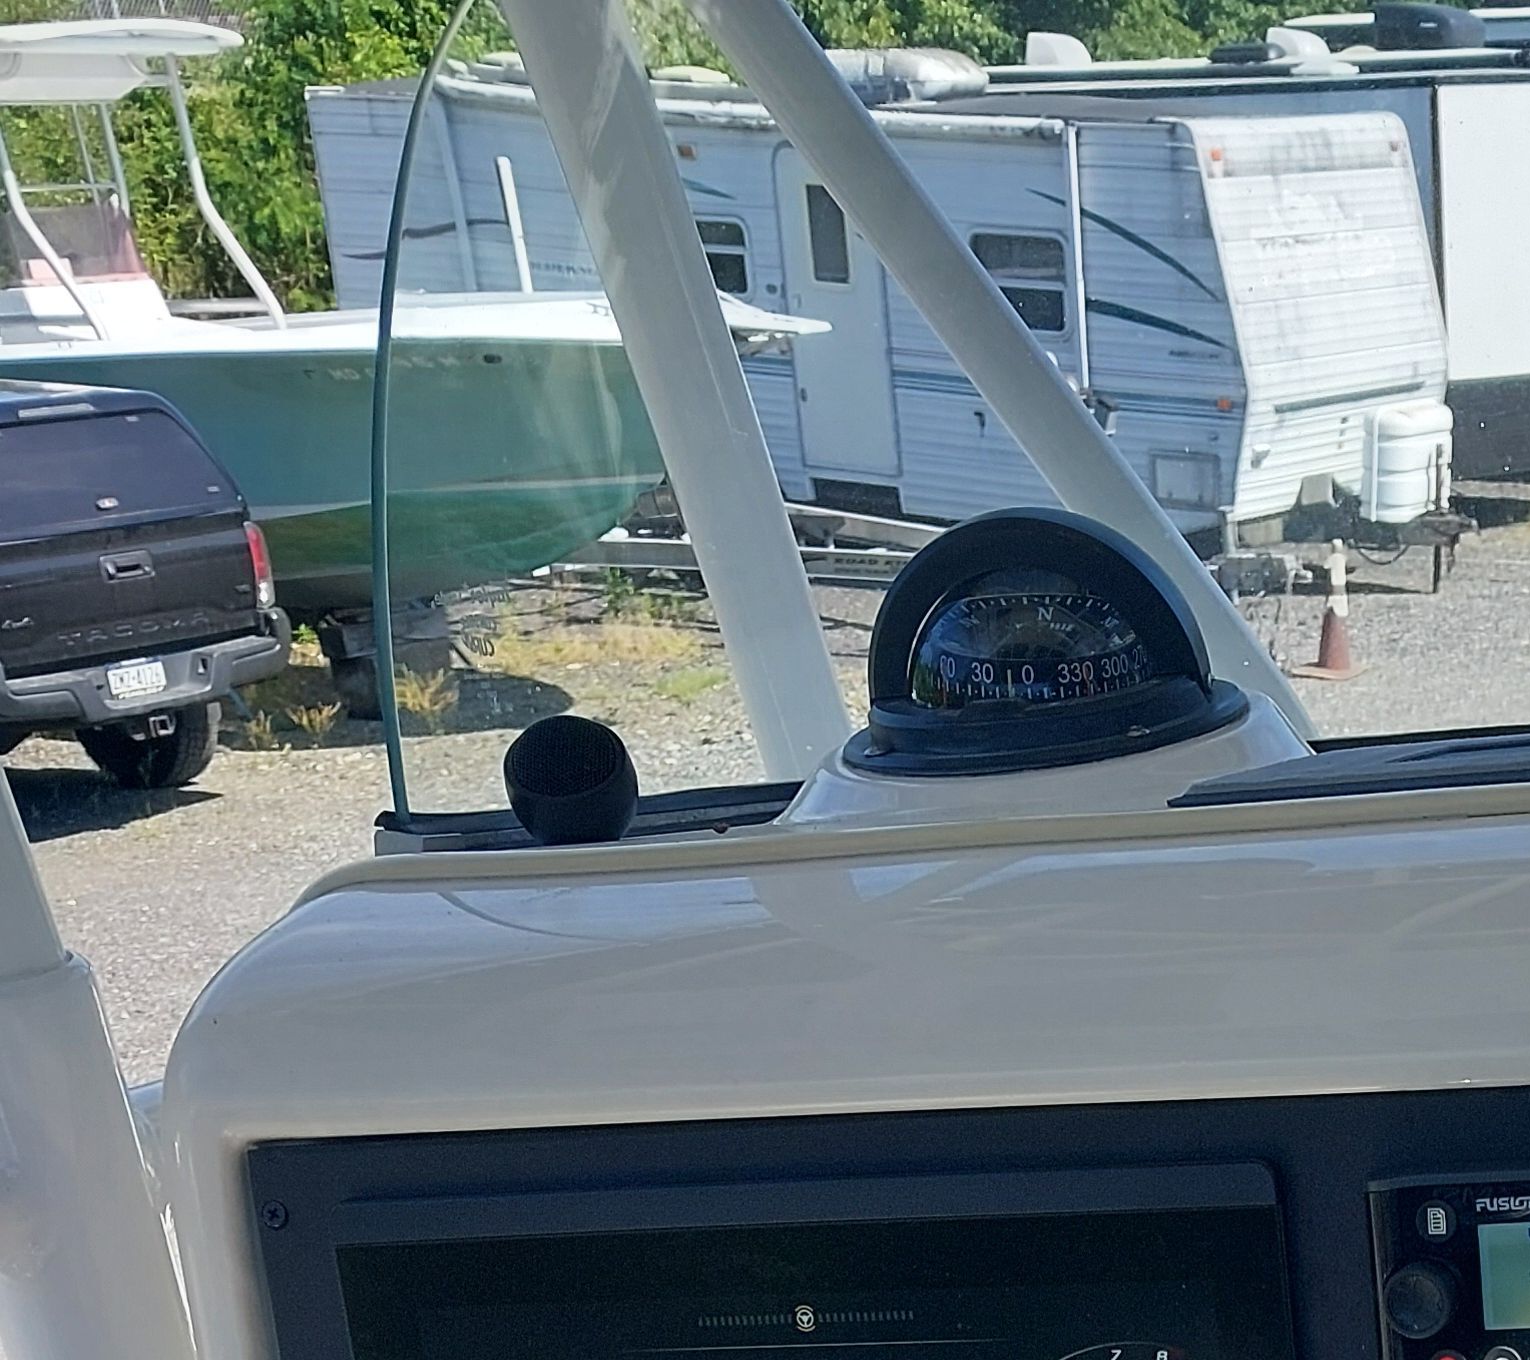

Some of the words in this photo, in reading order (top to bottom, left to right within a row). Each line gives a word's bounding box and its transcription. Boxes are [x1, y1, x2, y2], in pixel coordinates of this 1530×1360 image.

[971, 662, 994, 683] 30
[1021, 664, 1035, 685] 0
[1058, 661, 1094, 683] 330
[1102, 654, 1129, 679] 300
